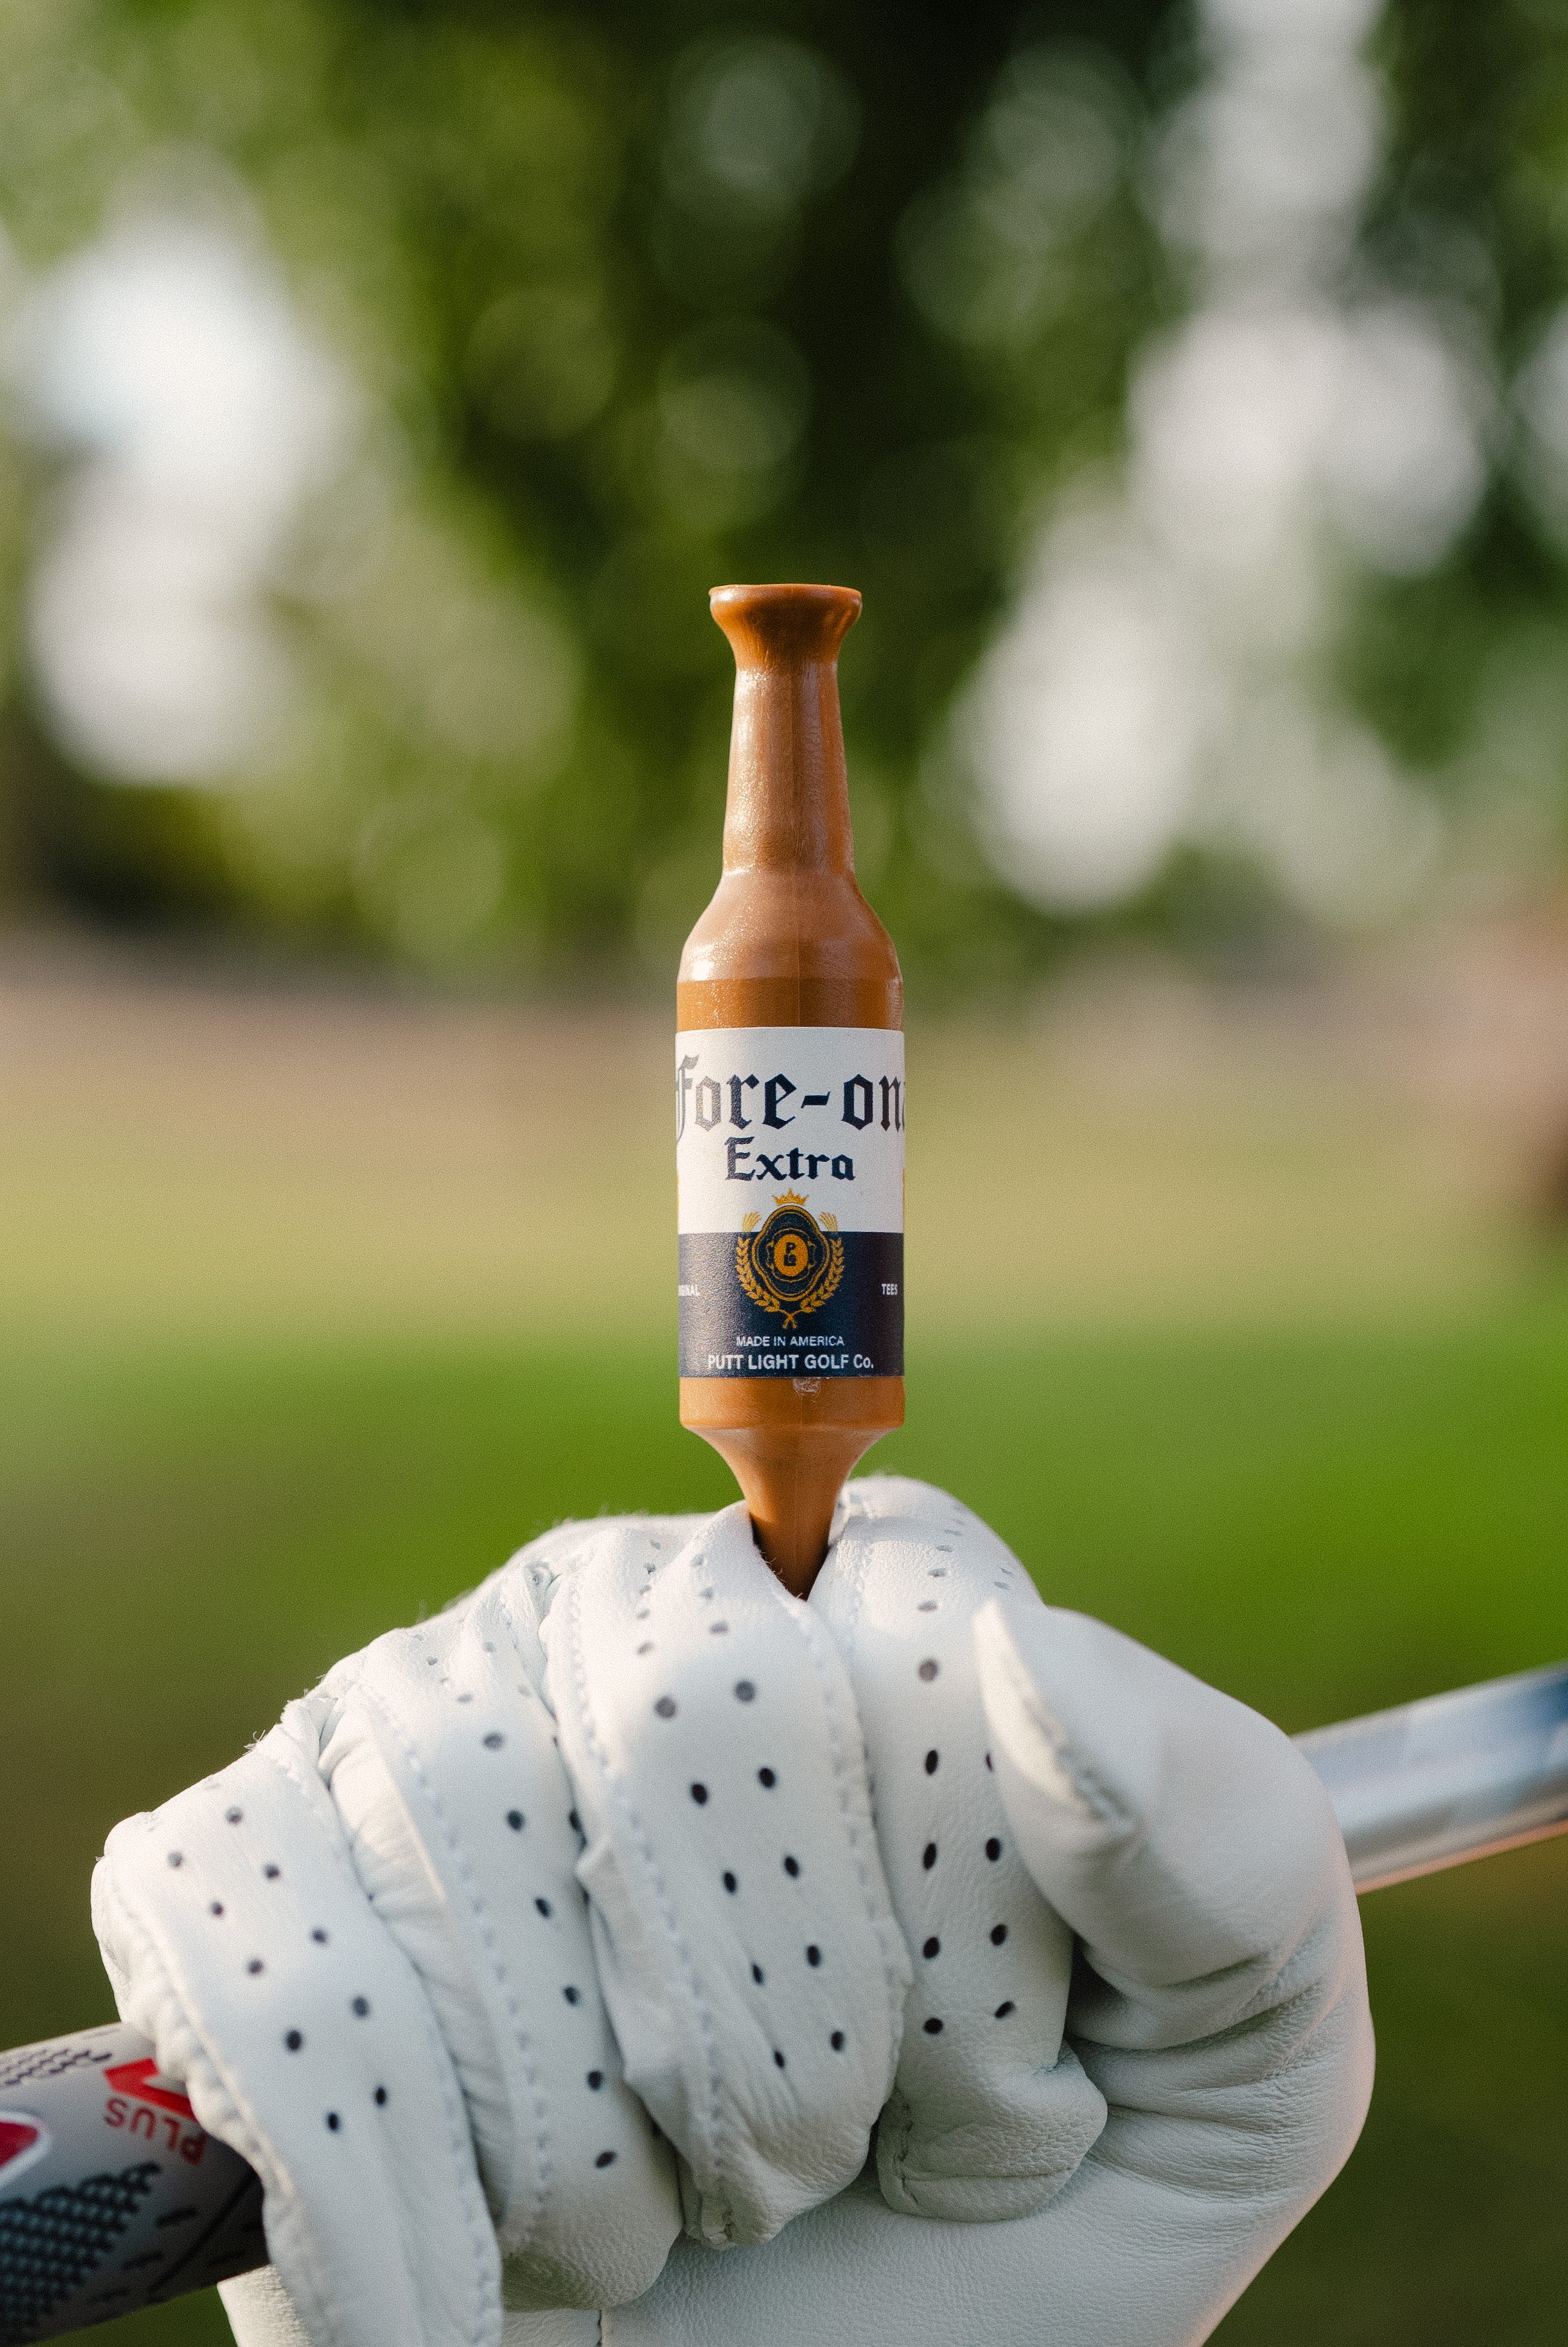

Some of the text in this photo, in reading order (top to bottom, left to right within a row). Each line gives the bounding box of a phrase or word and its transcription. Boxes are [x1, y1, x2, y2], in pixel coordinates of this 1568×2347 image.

[676, 1054, 904, 1144] fore-on
[725, 1136, 856, 1181] Extra
[881, 1283, 898, 1296] TEES
[736, 1335, 845, 1347] MADE IN AMERICA
[707, 1354, 874, 1369] PUTT LIGHT GOLF Co.
[104, 2098, 207, 2166] PLUS
